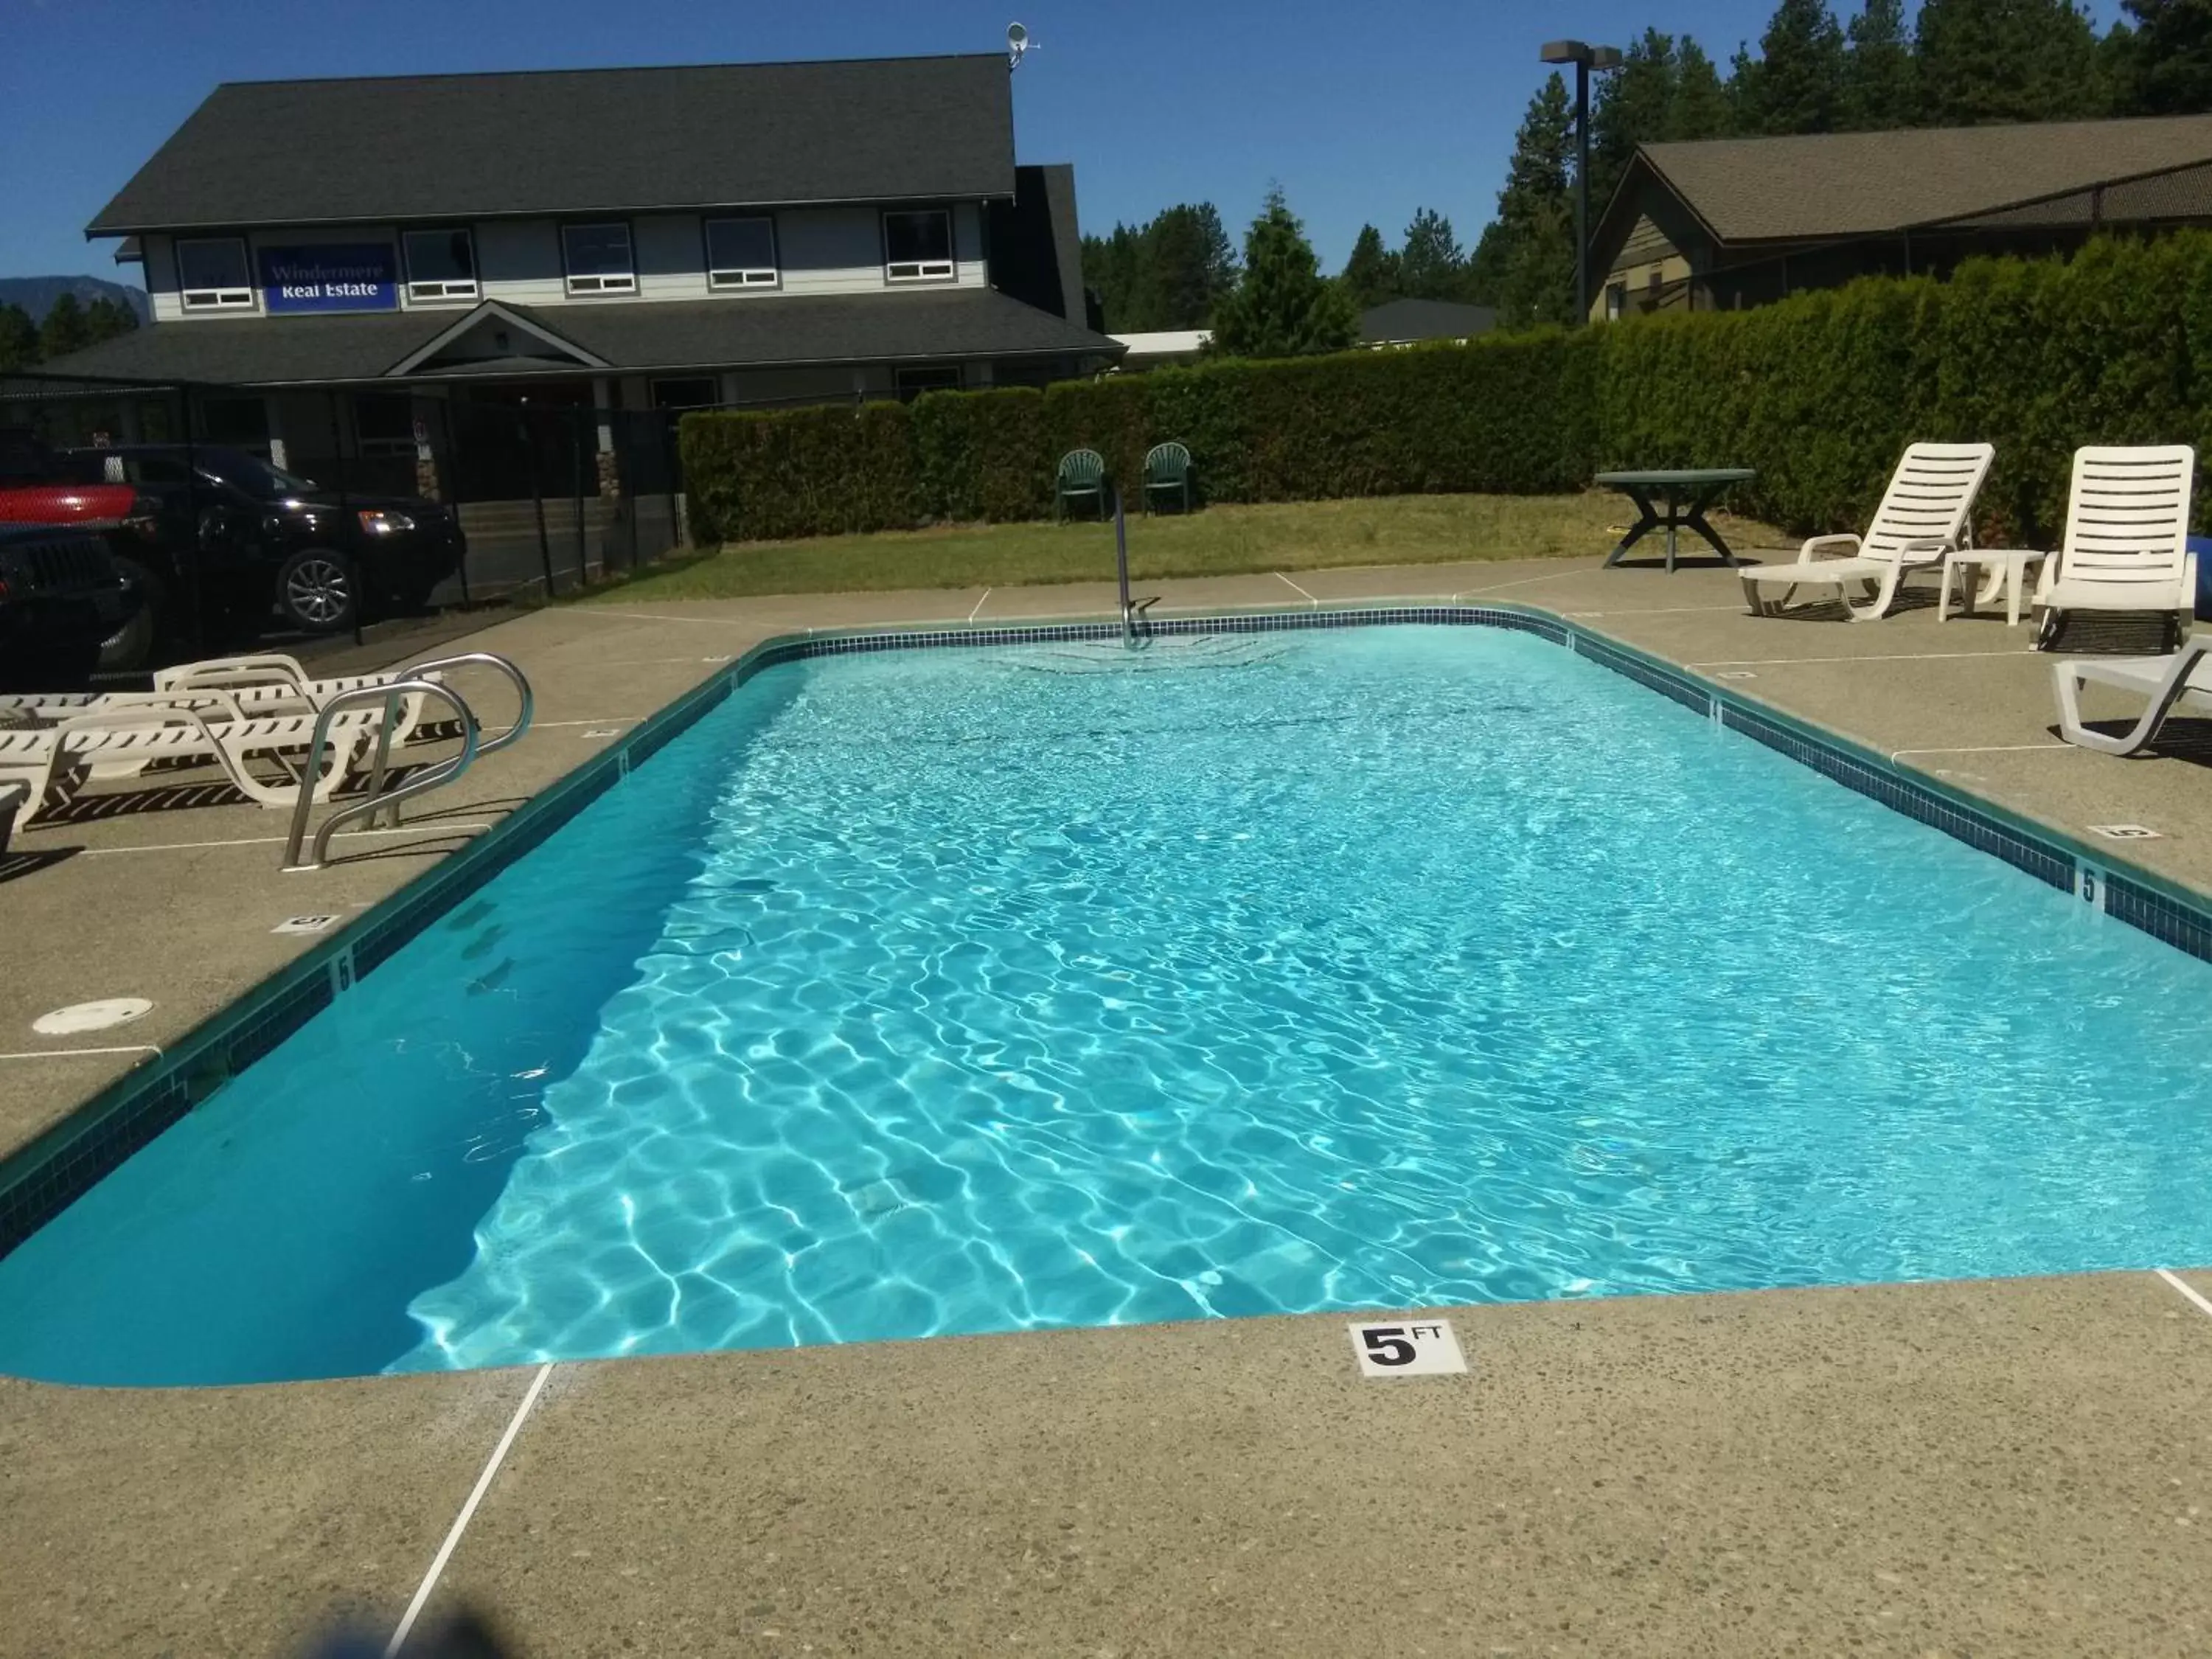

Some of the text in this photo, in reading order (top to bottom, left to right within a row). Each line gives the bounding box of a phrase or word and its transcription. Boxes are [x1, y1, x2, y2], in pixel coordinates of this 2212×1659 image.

[271, 262, 383, 281] Windermere
[282, 280, 378, 298] Real Estate
[2083, 868, 2096, 902] 5
[1363, 1326, 1442, 1366] 5 FT
